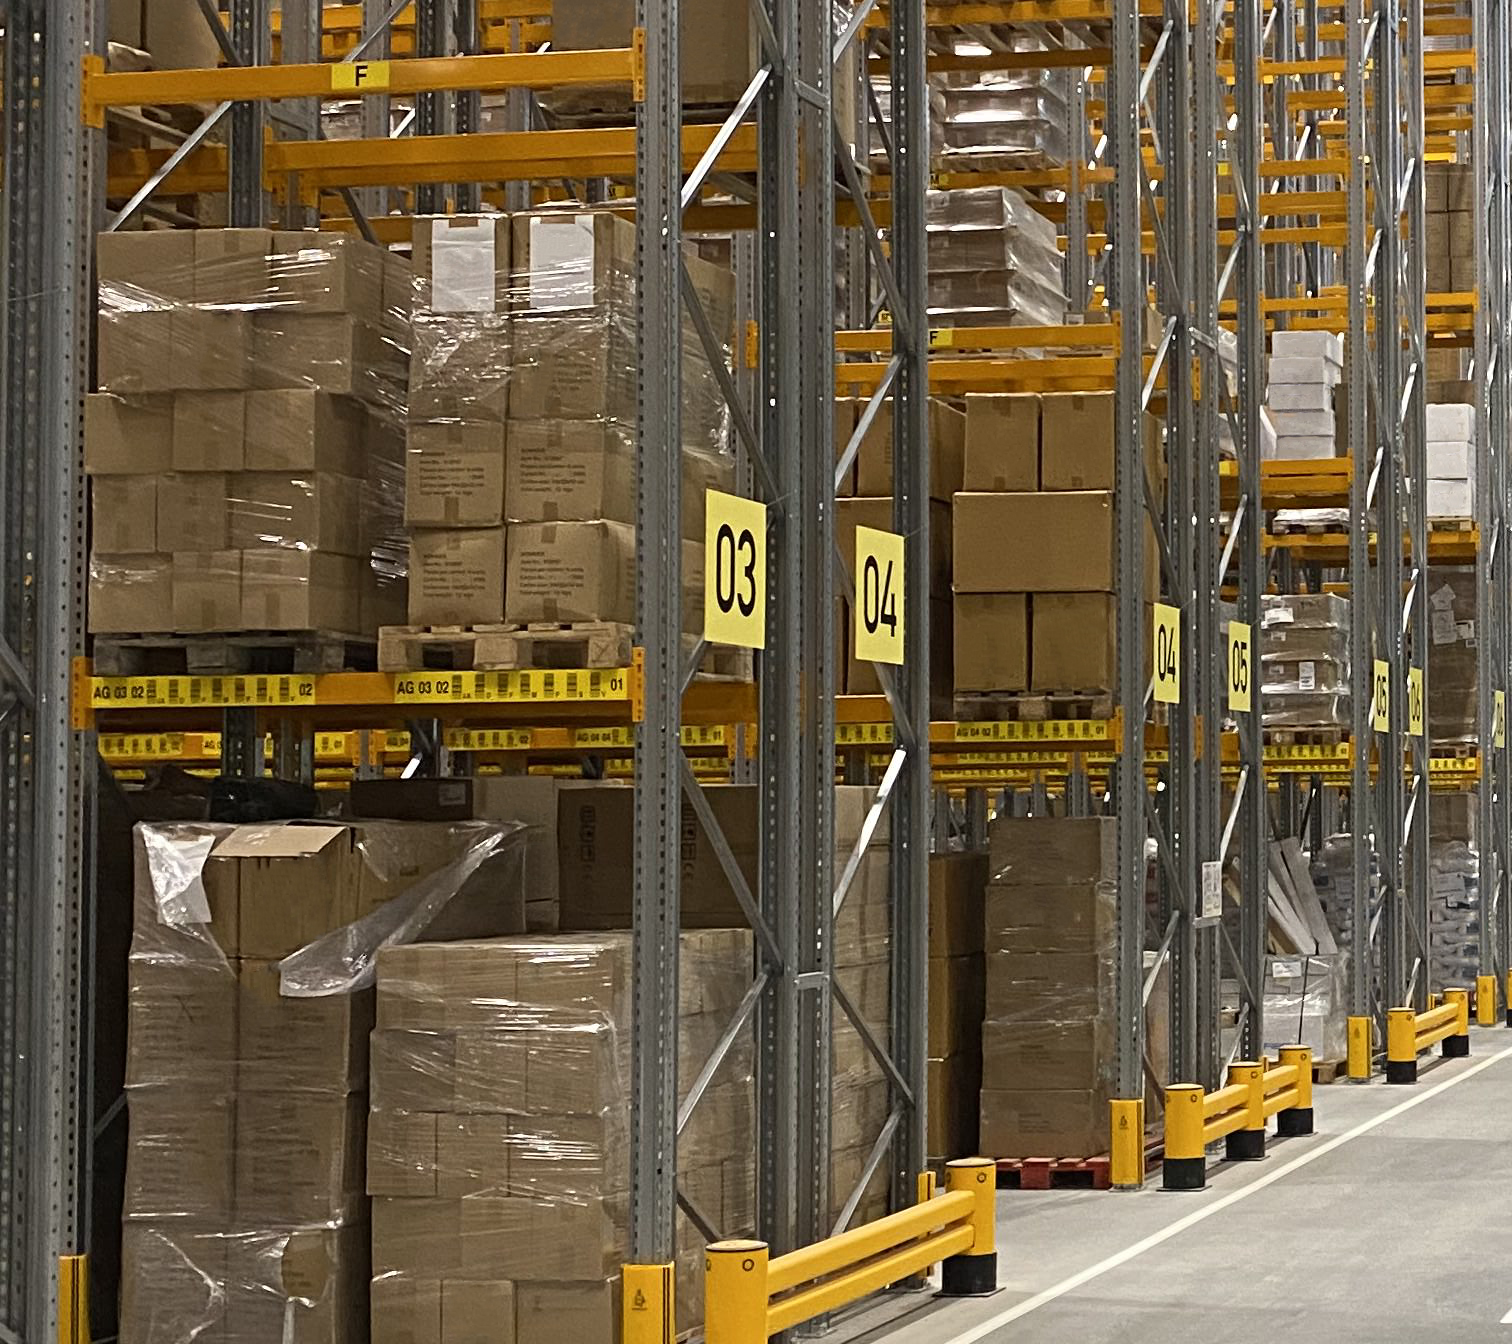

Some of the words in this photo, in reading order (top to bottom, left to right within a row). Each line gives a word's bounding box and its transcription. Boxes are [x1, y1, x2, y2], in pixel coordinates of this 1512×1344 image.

[355, 65, 368, 87] F
[929, 330, 939, 345] F
[715, 523, 757, 618] 03
[863, 554, 897, 637] 04
[1157, 623, 1176, 684] 04
[1232, 639, 1248, 694] 05
[93, 686, 111, 699] AG
[114, 686, 128, 699] 03
[130, 685, 145, 699] 02
[298, 683, 313, 696] 02
[396, 681, 415, 694] AG
[417, 681, 432, 694] 03
[435, 680, 450, 694] 02
[610, 678, 624, 691] 01
[1376, 674, 1387, 718] 05
[1411, 681, 1421, 722] 06
